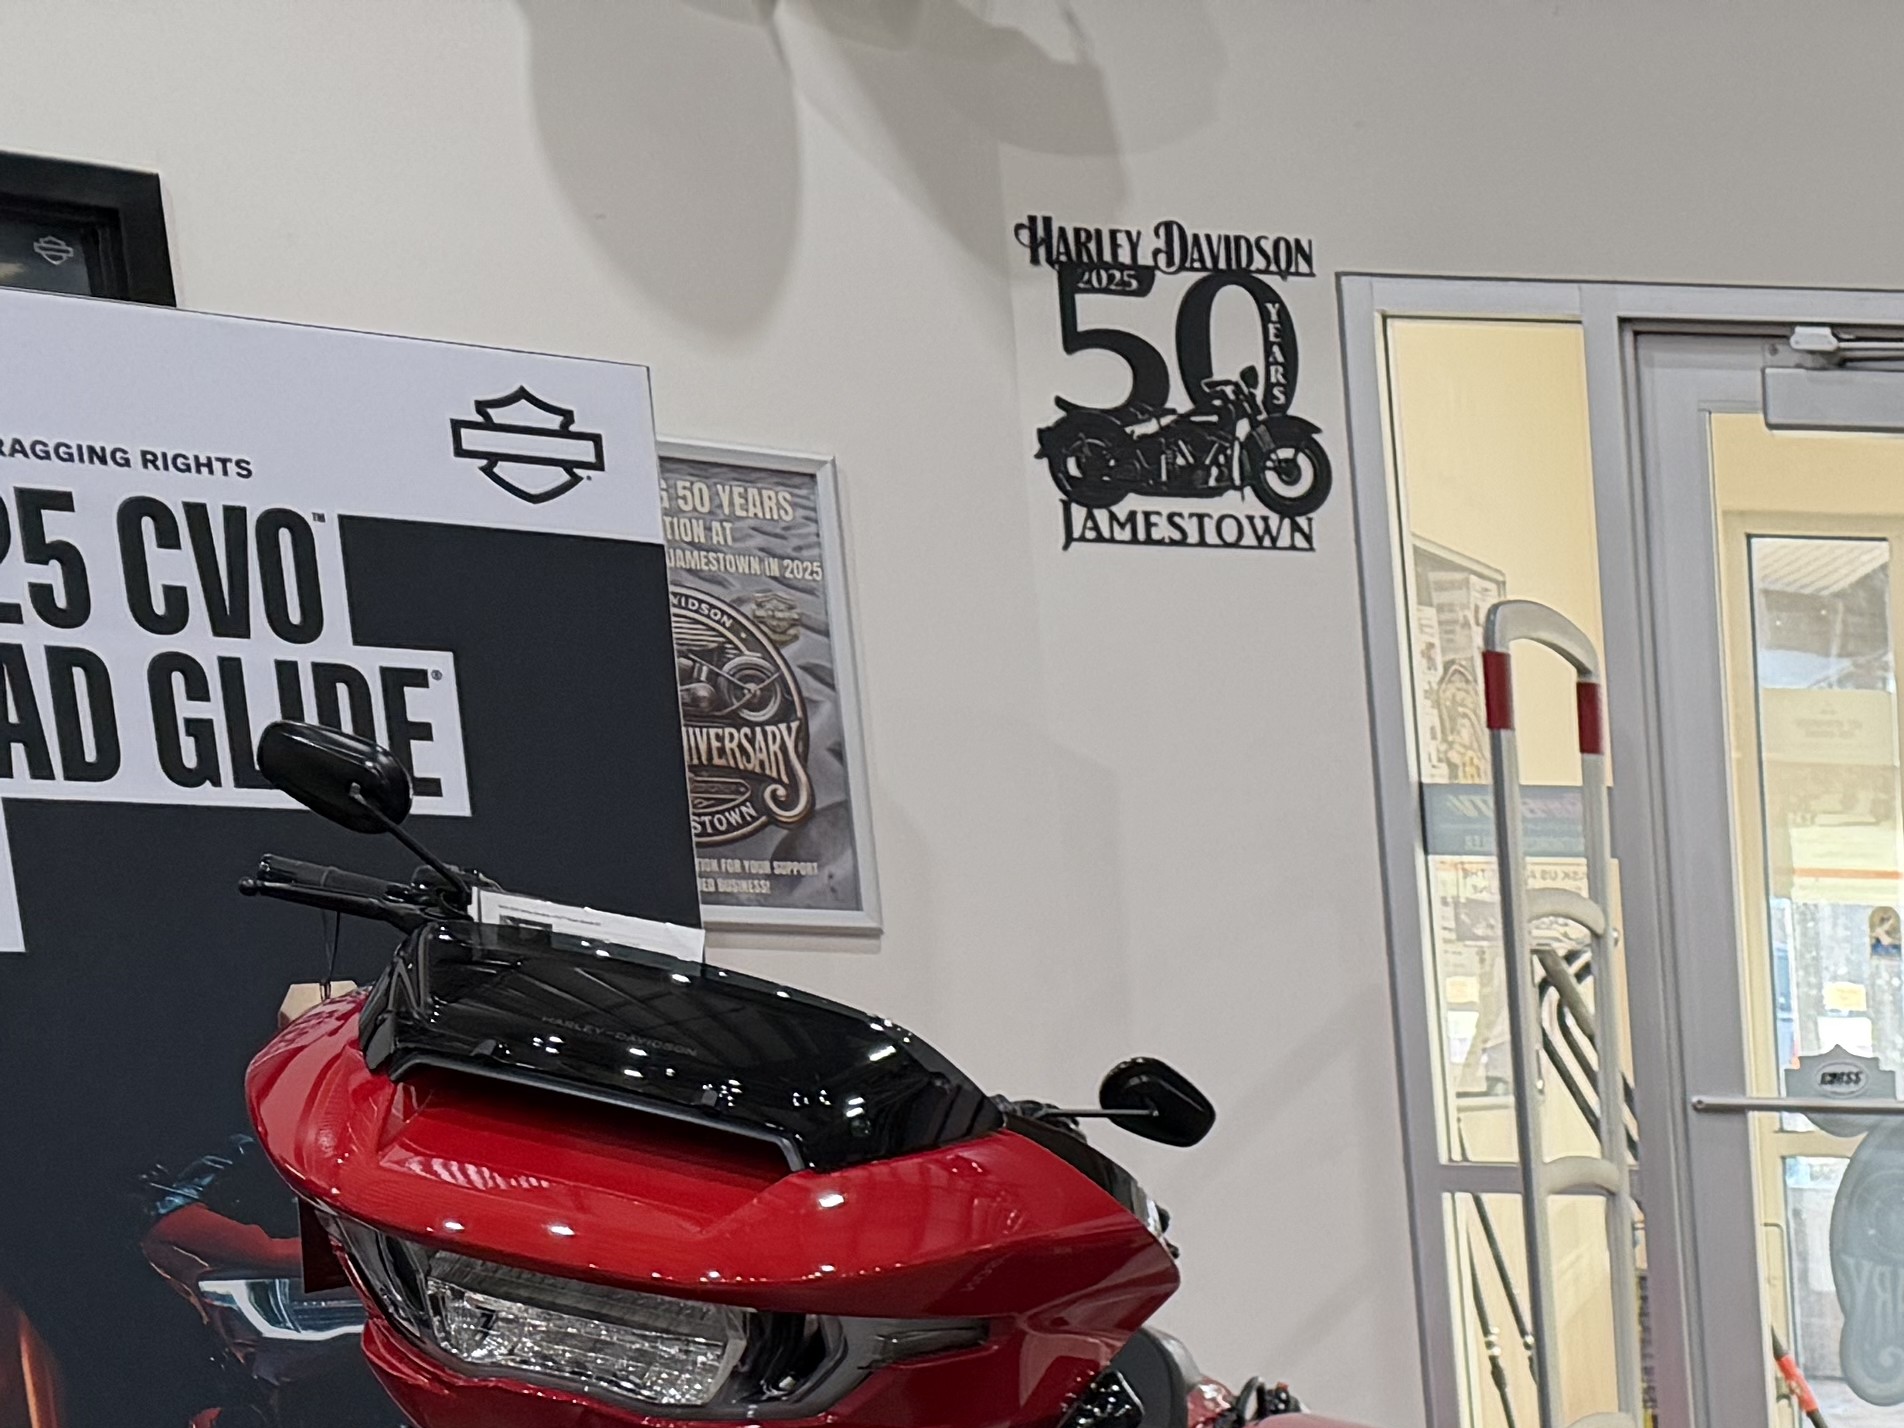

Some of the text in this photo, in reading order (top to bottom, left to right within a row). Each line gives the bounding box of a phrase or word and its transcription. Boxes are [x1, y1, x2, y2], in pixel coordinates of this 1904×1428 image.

[1013, 215, 1316, 280] HARLEY DAVIDSON
[1076, 269, 1139, 290] 2025
[1055, 266, 1299, 417] 50
[1263, 303, 1287, 405] YEARS
[140, 449, 254, 480] RIGHTS
[677, 480, 712, 514] 50
[716, 484, 795, 522] YEARS
[1058, 498, 1316, 551] JAMESTOWN
[0, 486, 91, 629] 5
[711, 521, 734, 547] AT
[667, 548, 823, 581] JAMESTOWN IN 2025
